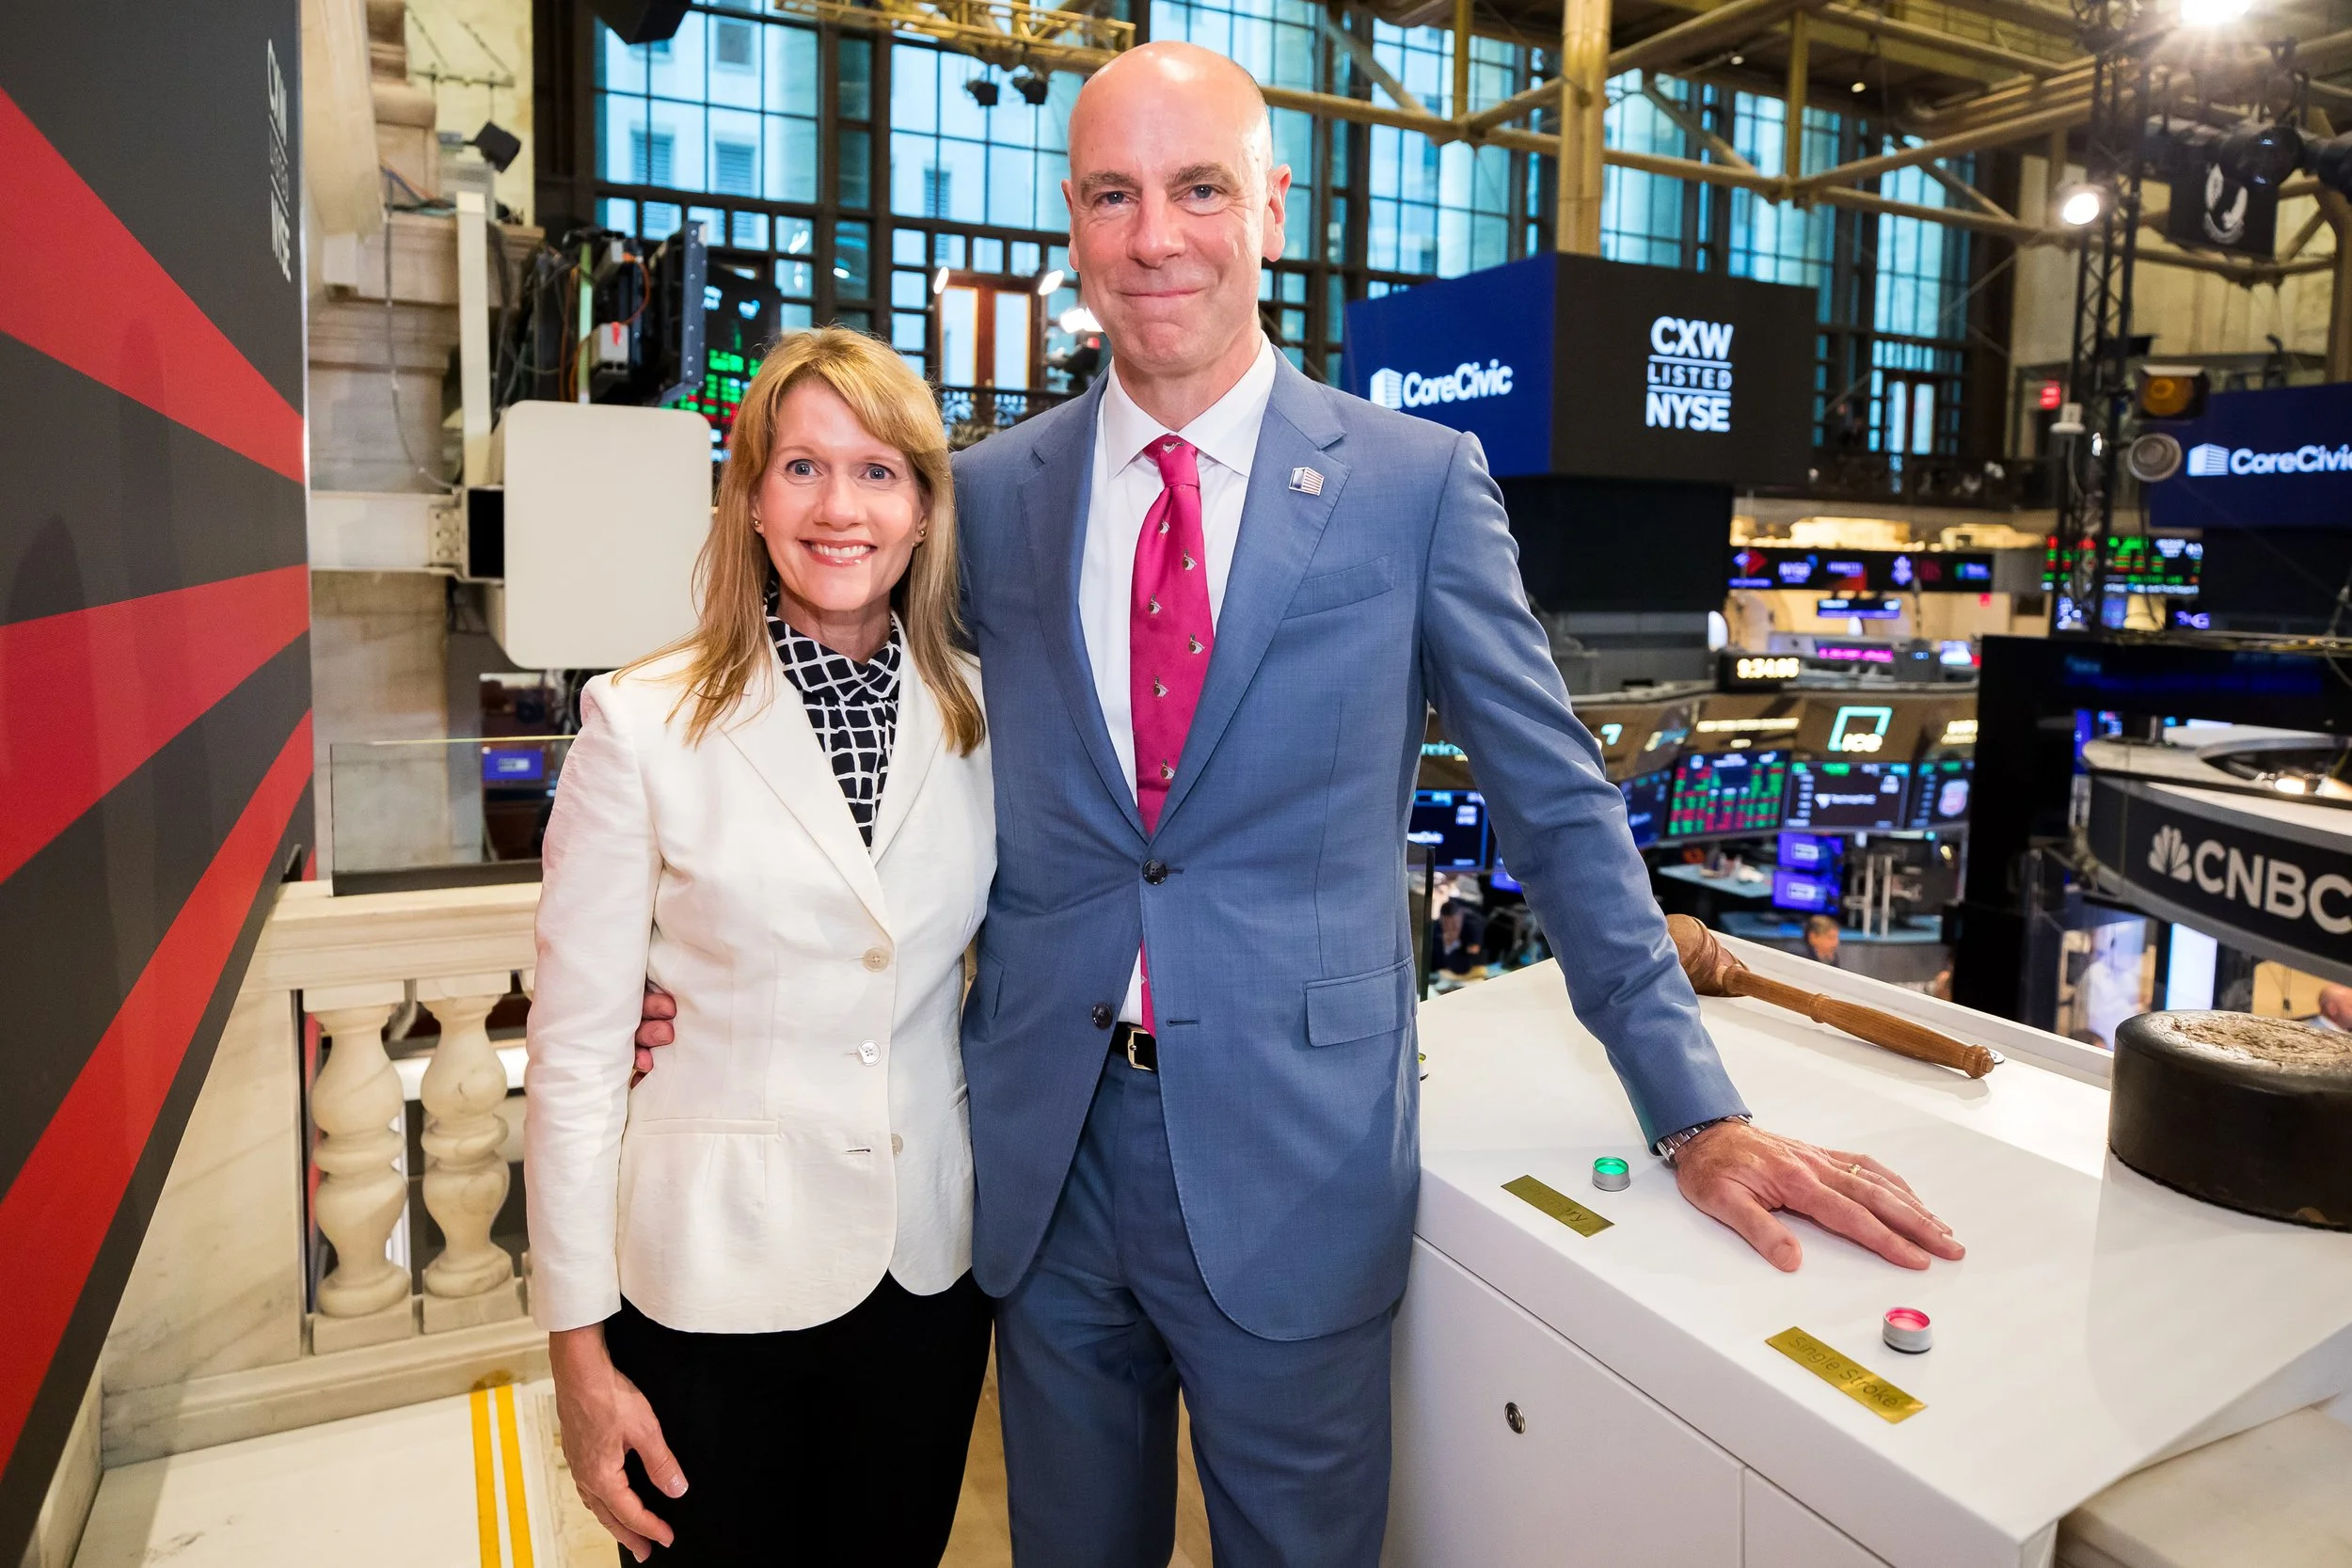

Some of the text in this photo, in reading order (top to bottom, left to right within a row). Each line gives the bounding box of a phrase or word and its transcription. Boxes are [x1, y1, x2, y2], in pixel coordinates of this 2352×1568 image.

[1650, 316, 1734, 360] CXW
[1403, 358, 1513, 408] CoreCivic
[1647, 363, 1732, 389] LISTED
[1645, 392, 1731, 433] NYSE
[2230, 444, 2352, 475] CoreCivi
[2194, 839, 2352, 934] CNBC
[1788, 1336, 1899, 1408] Single Stroke
